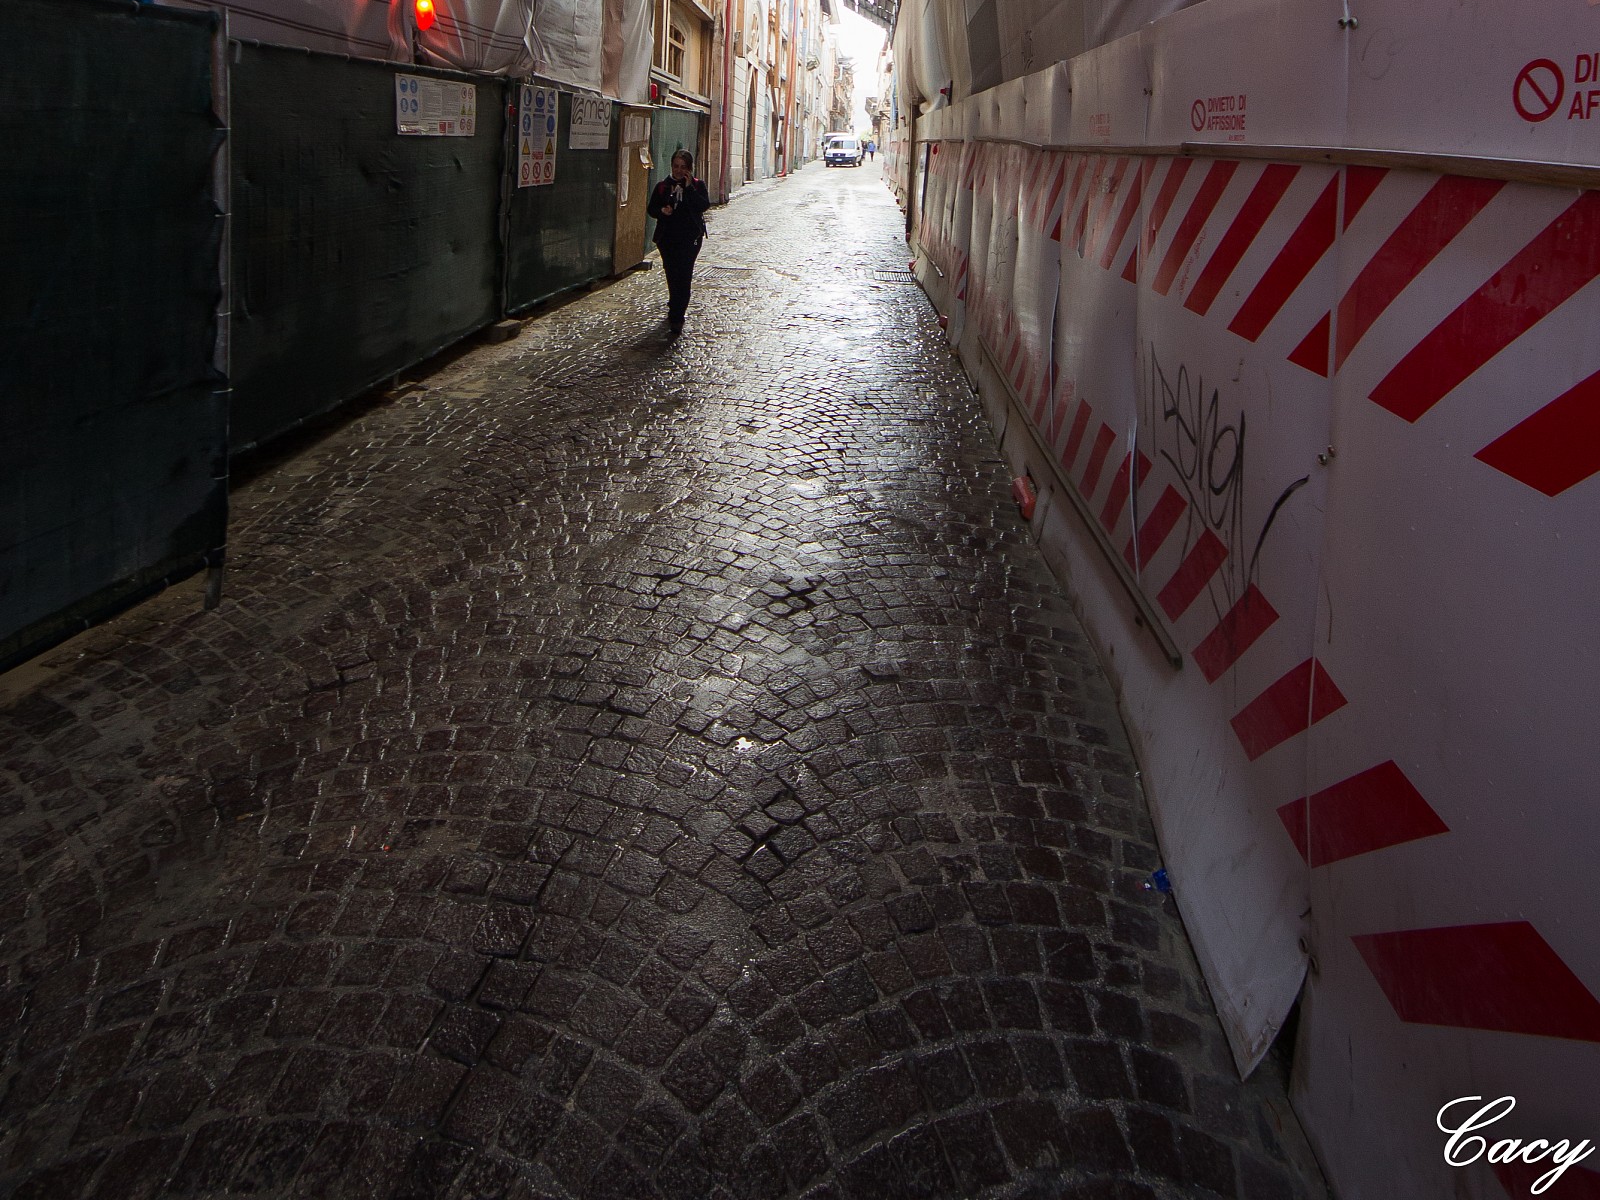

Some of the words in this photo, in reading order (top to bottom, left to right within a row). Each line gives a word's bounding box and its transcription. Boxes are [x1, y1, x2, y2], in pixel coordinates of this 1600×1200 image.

[1208, 96, 1235, 112] DIVIETO
[1238, 94, 1246, 111] DI
[1207, 115, 1246, 131] AFFISSIONE
